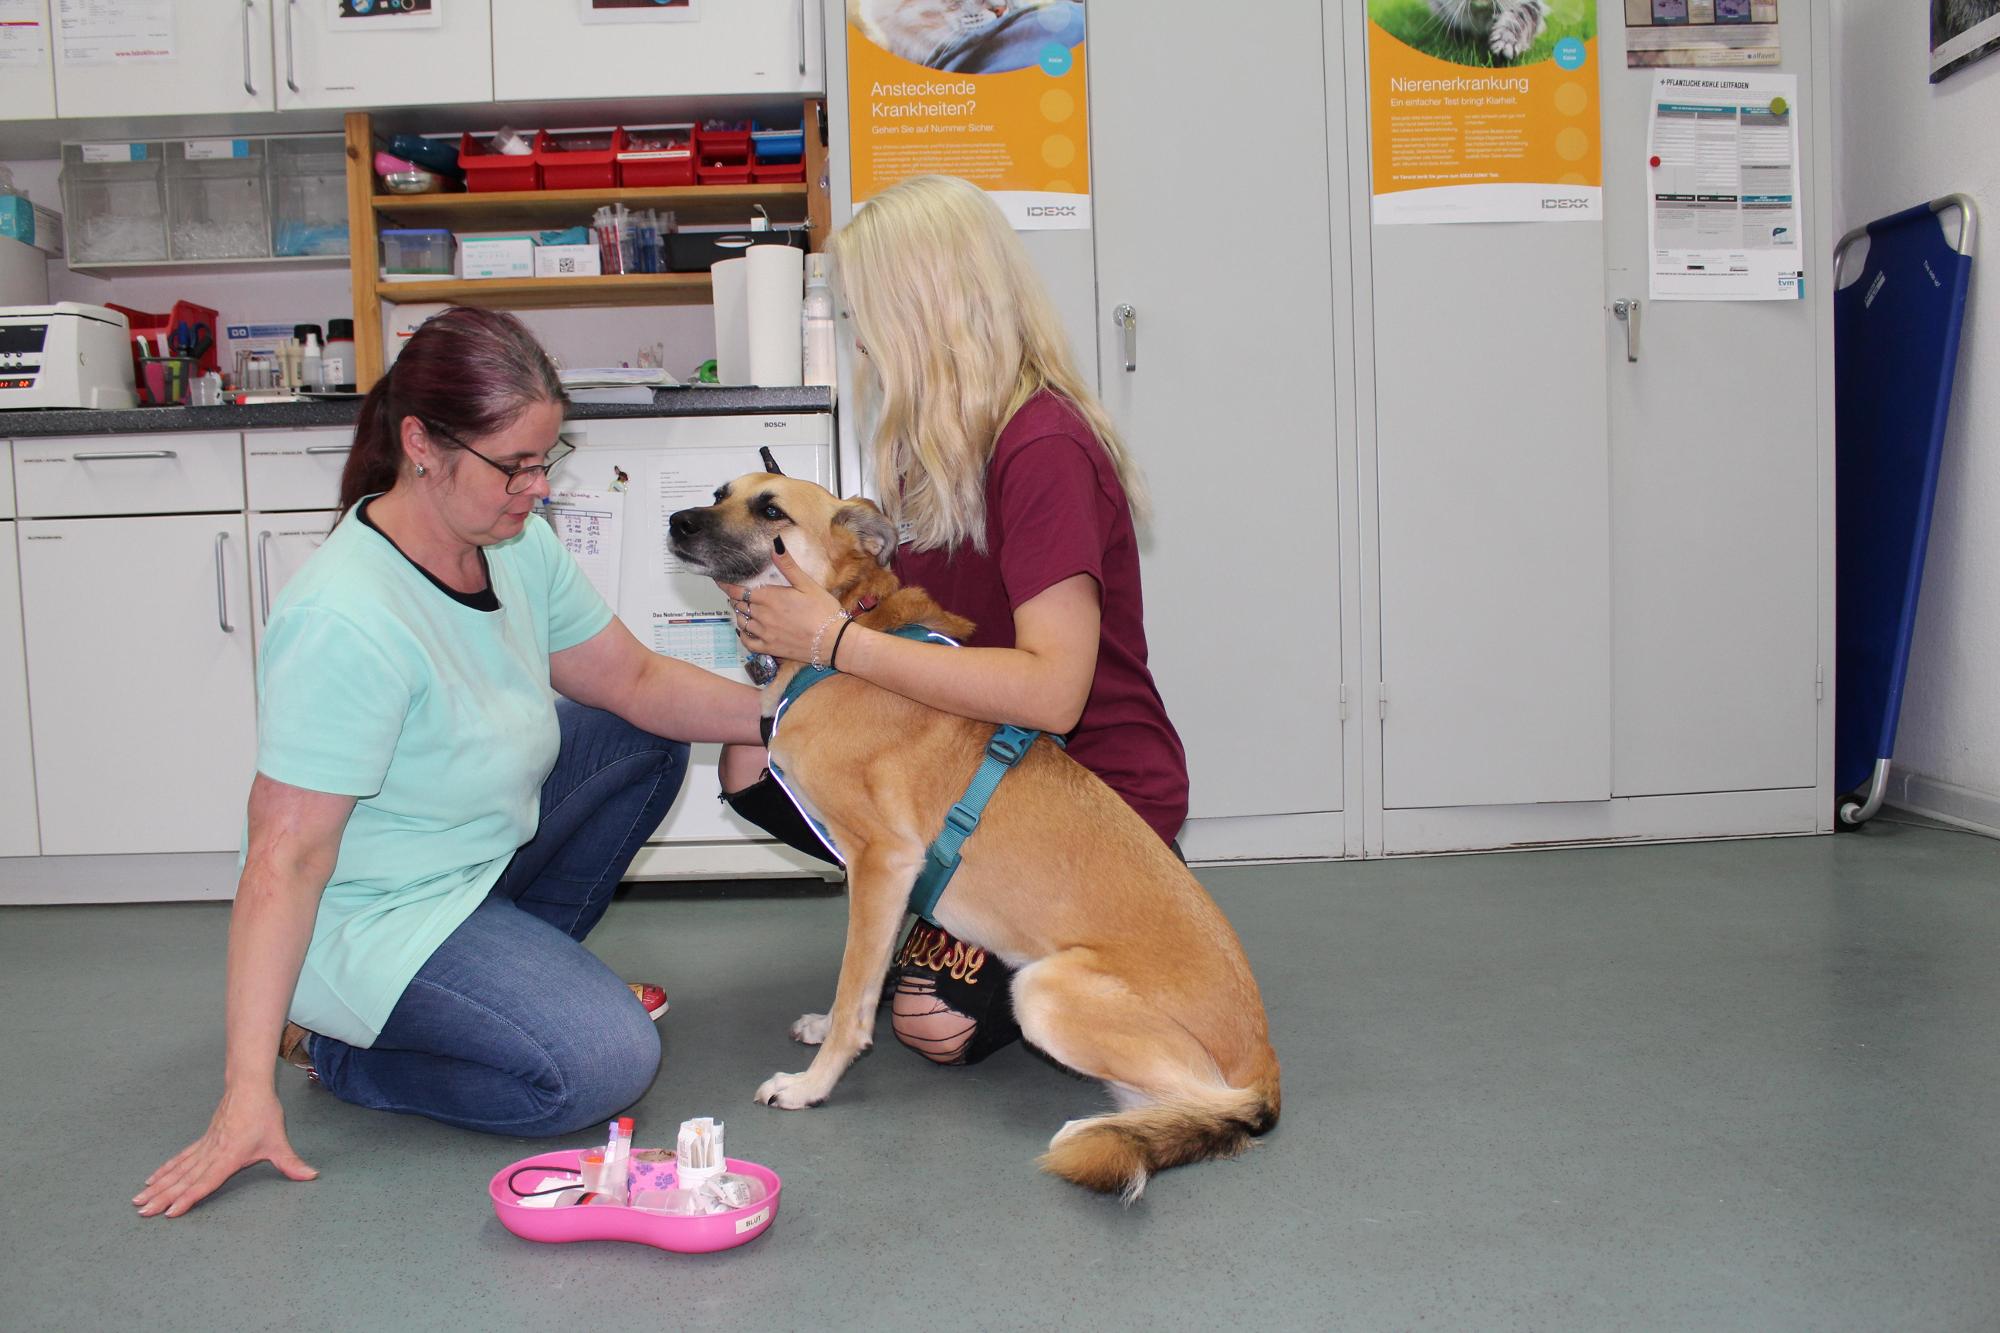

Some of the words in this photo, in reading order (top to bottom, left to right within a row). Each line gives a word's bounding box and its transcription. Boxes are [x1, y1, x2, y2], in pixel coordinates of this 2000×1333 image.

[871, 81, 976, 97] Ansteckende
[1391, 76, 1529, 93] Nierenerkrankung
[1666, 78, 1701, 88] PFLANZLICHE
[1701, 80, 1719, 88] KOHLE
[1719, 81, 1749, 89] LEITFADEN
[1391, 98, 1404, 107] Ein
[1405, 98, 1441, 106] einfacher
[1444, 97, 1459, 105] Test
[1461, 97, 1484, 106] bringt
[1486, 96, 1518, 105] Klarheit.
[871, 101, 976, 118] Krankheiten?
[872, 125, 900, 135] Gehen
[901, 125, 913, 133] Sie
[915, 124, 929, 133] auf
[931, 124, 966, 133] Nummer
[1541, 198, 1589, 209] IDEXX
[1027, 206, 1077, 217] IDEXX
[1778, 279, 1795, 287] tvm
[745, 1216, 761, 1227] BLUT
